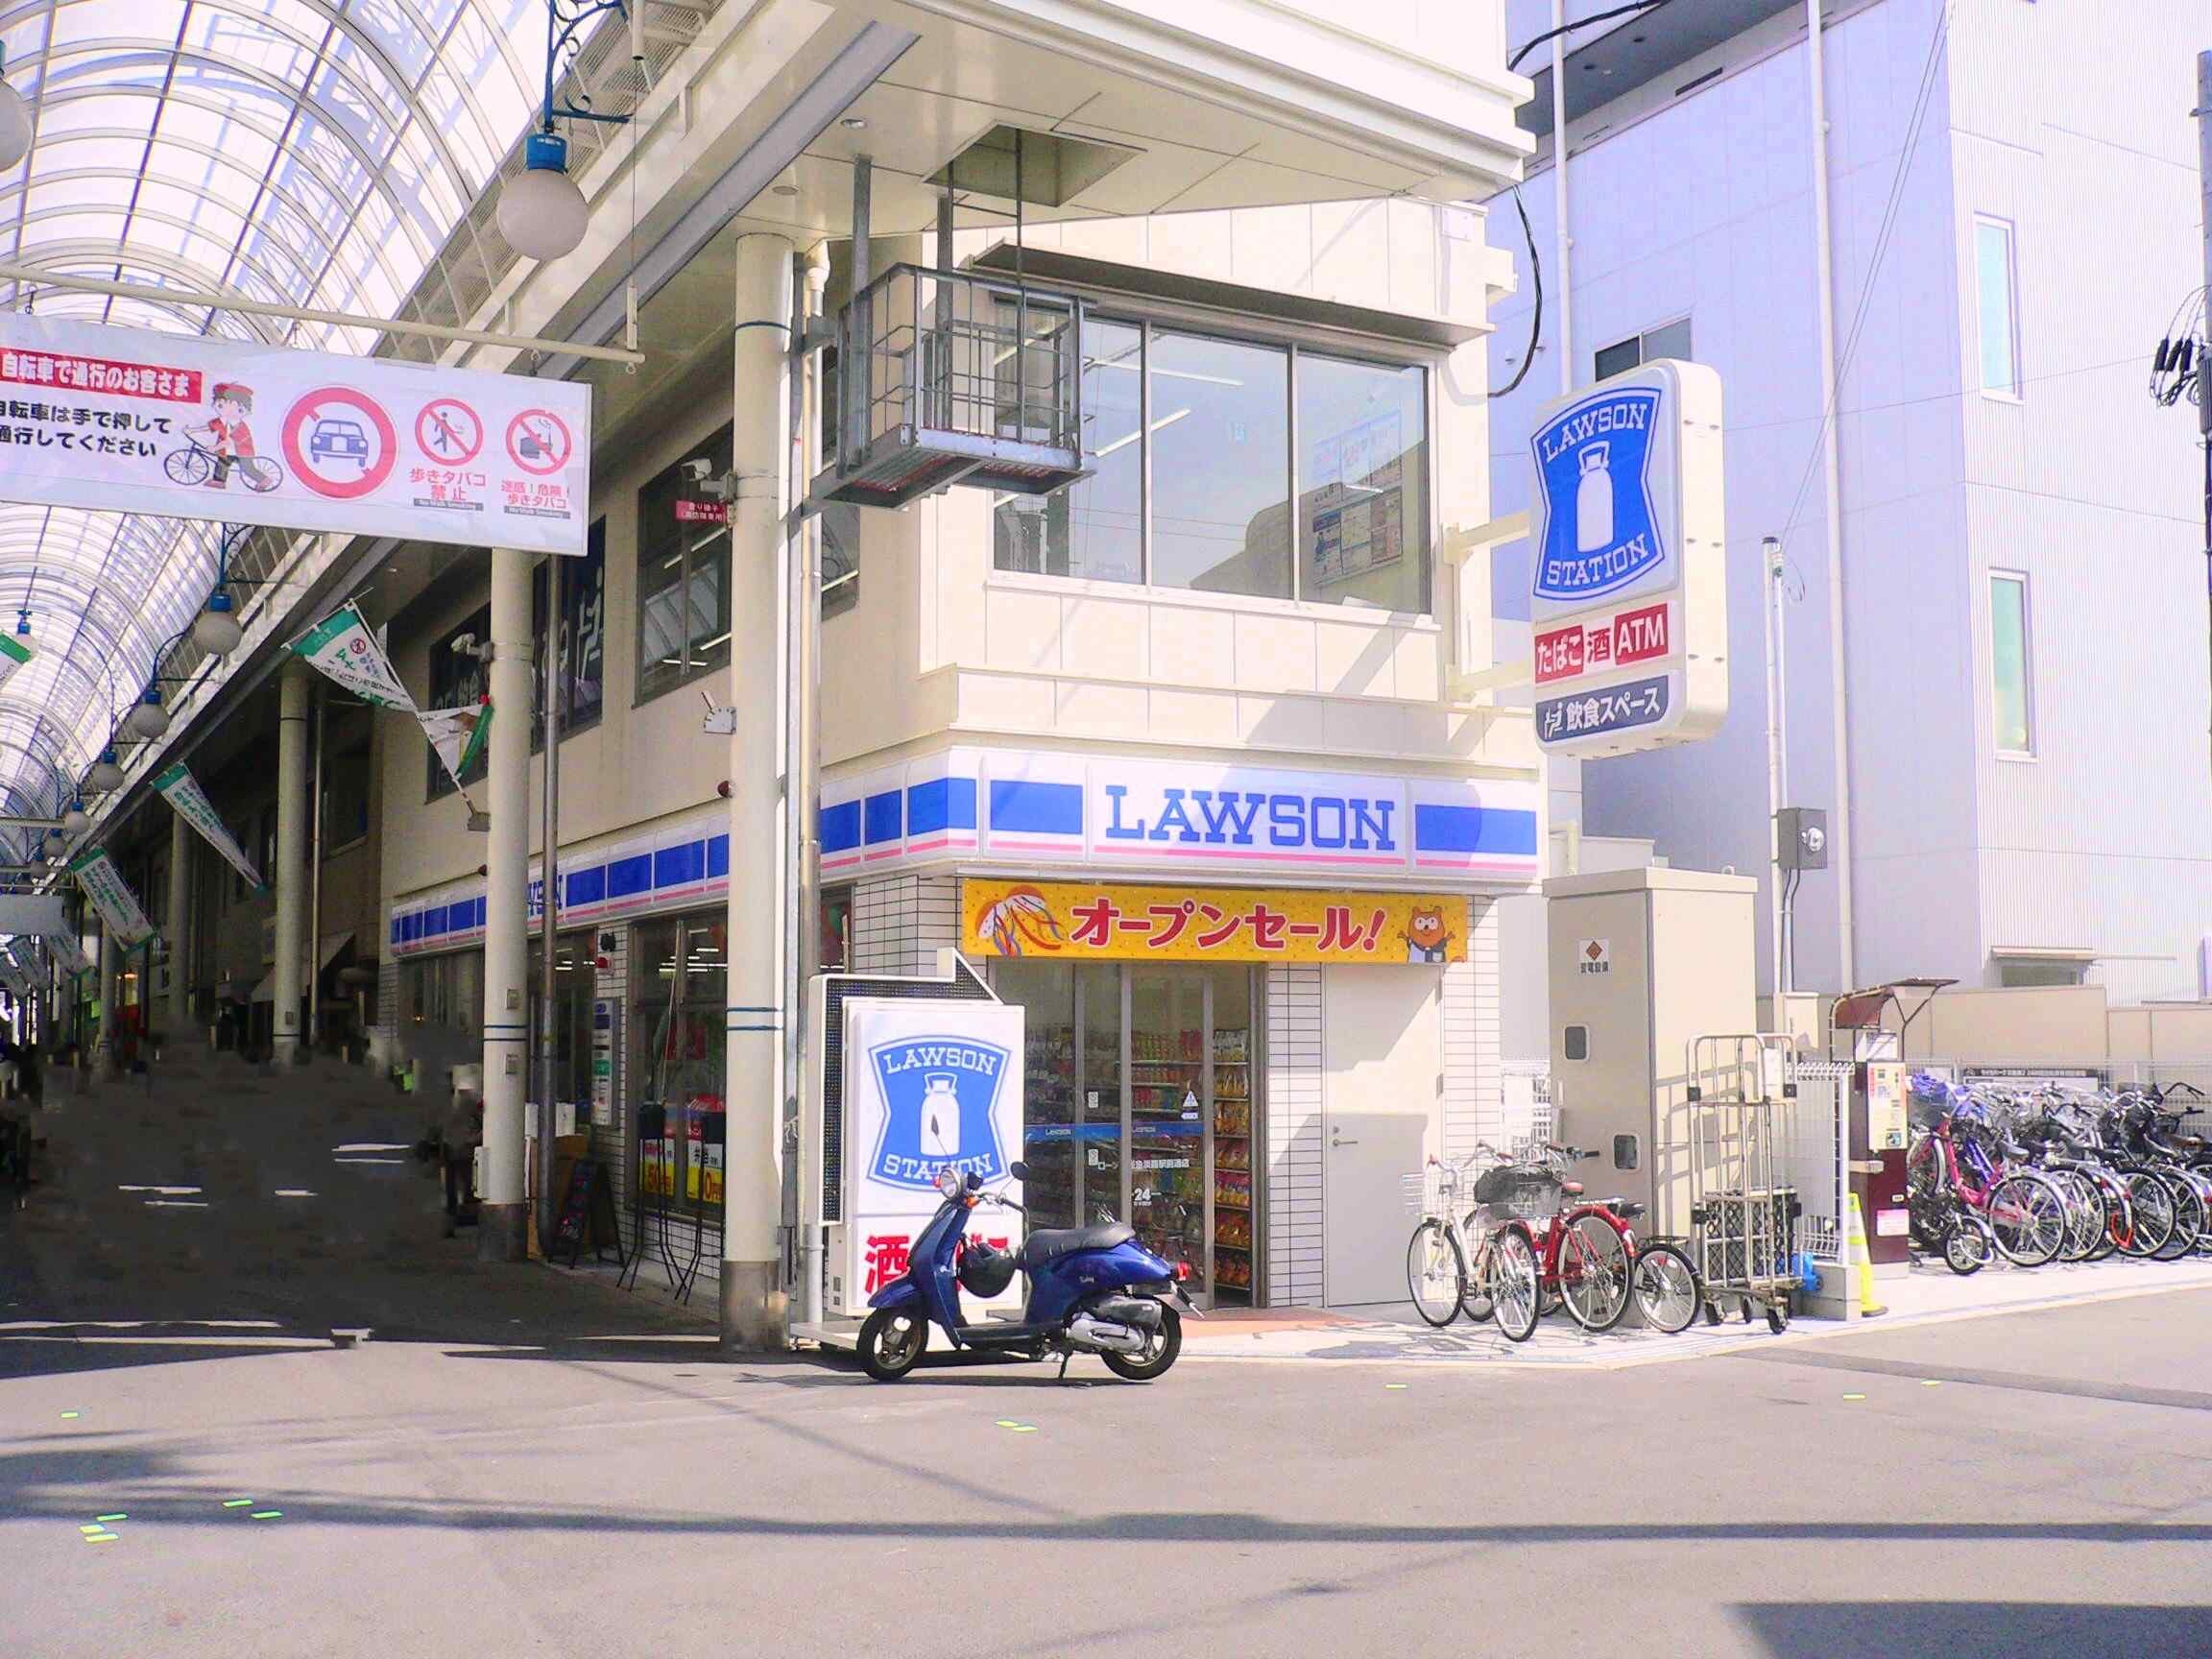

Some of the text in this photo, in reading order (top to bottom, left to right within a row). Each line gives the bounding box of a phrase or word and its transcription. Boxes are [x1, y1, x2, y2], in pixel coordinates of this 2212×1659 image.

[2, 351, 192, 397] 自転車で通行のお客さま
[1544, 403, 1647, 462] LAWSON
[410, 468, 486, 486] 歩きタバコ
[507, 492, 566, 509] 歩きタバコ
[1547, 533, 1649, 587] STATION
[1537, 613, 1665, 674] たばこ 酒 ATM
[1566, 686, 1661, 732] 飲食スペース
[1105, 785, 1396, 851] LAWSON
[1070, 896, 1387, 951] オープンセール！
[883, 1046, 997, 1076] LAWSON
[883, 1153, 994, 1181] STATON
